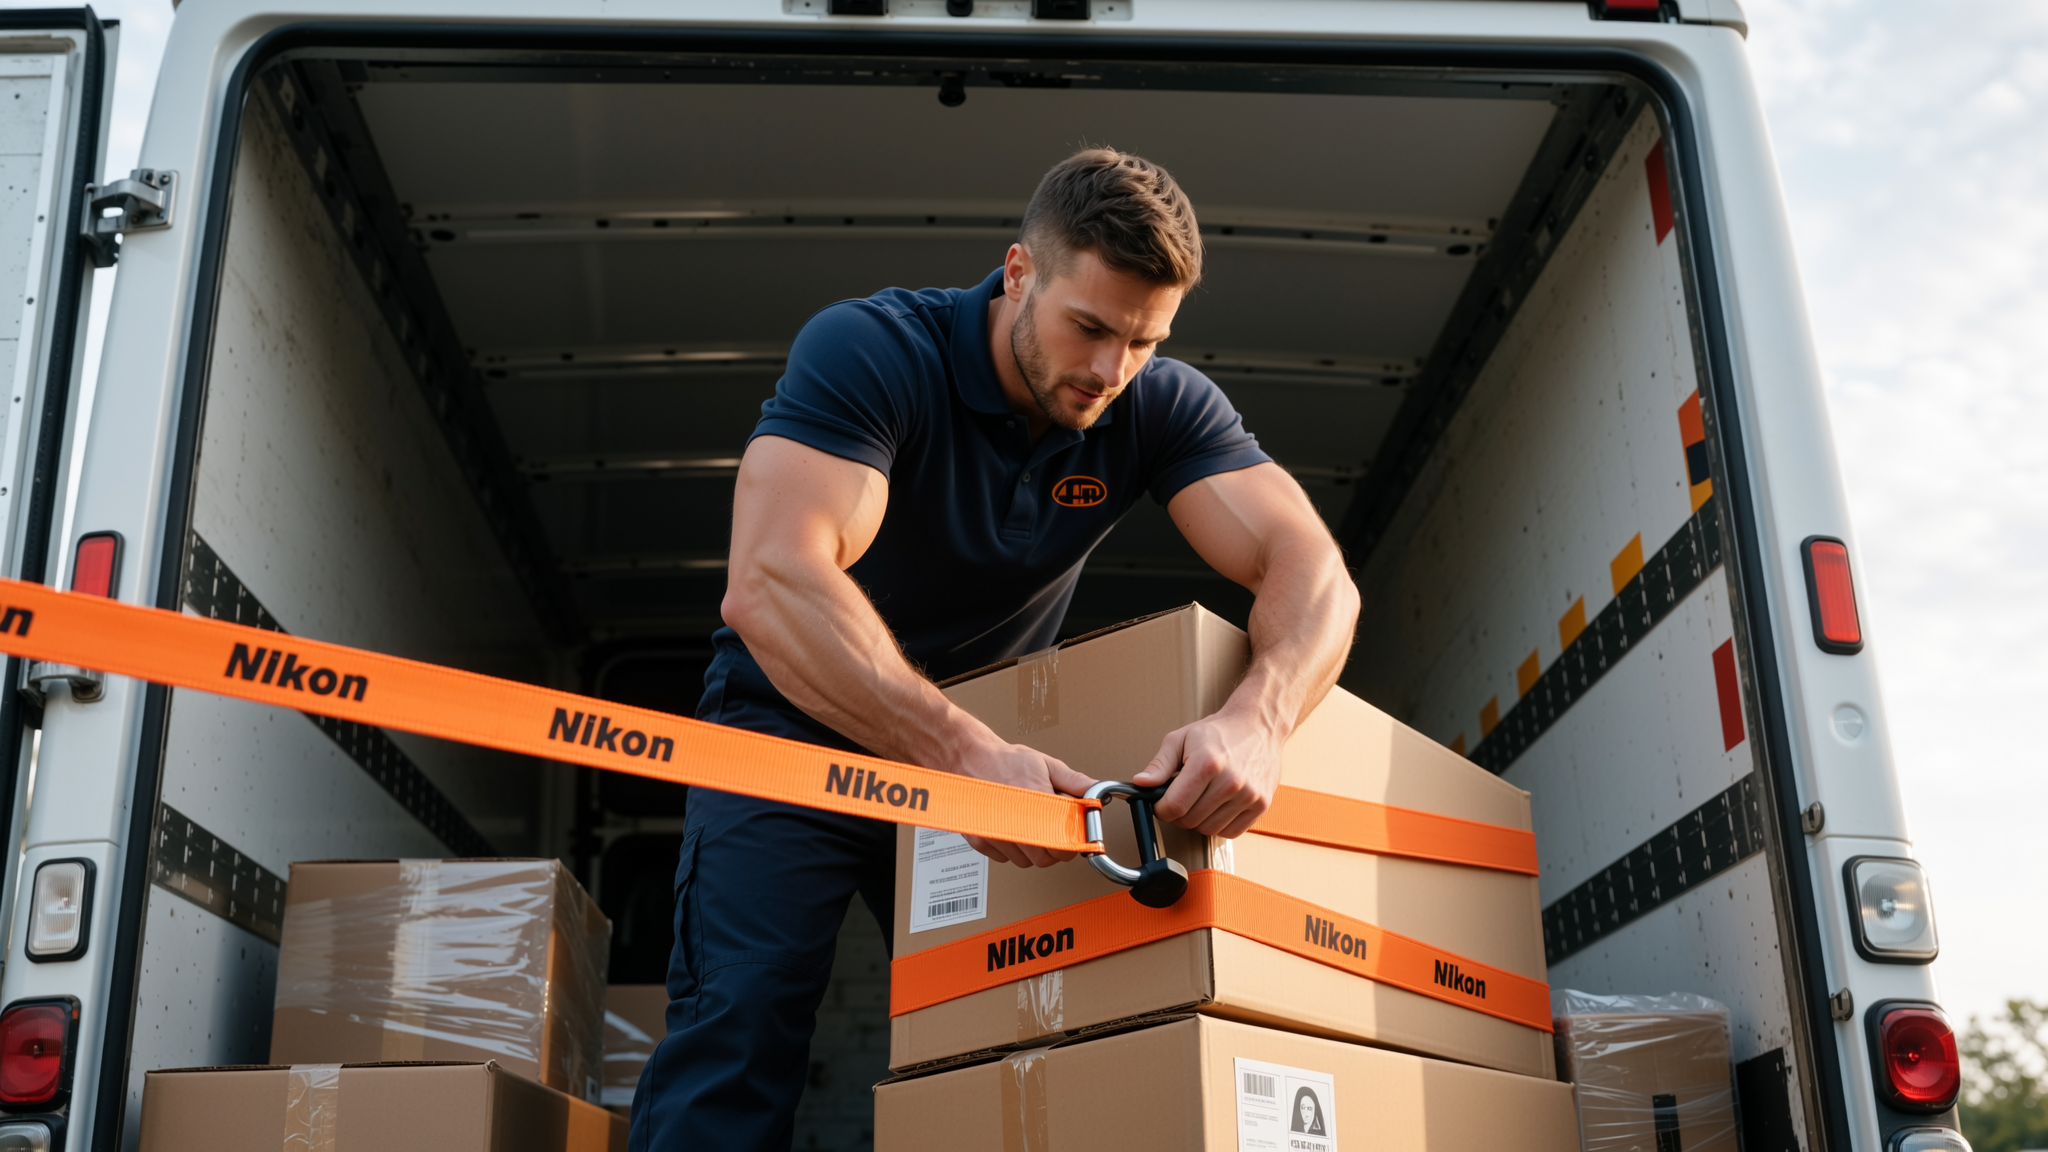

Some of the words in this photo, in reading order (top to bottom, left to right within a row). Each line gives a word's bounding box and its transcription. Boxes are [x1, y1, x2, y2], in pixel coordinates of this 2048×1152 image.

[224, 642, 369, 702] Nikon
[547, 707, 675, 763] Nikon
[825, 763, 930, 812] Nikon
[987, 927, 1074, 972] Nikon
[1304, 914, 1367, 960] Nikon
[1434, 959, 1486, 999] Nikon
